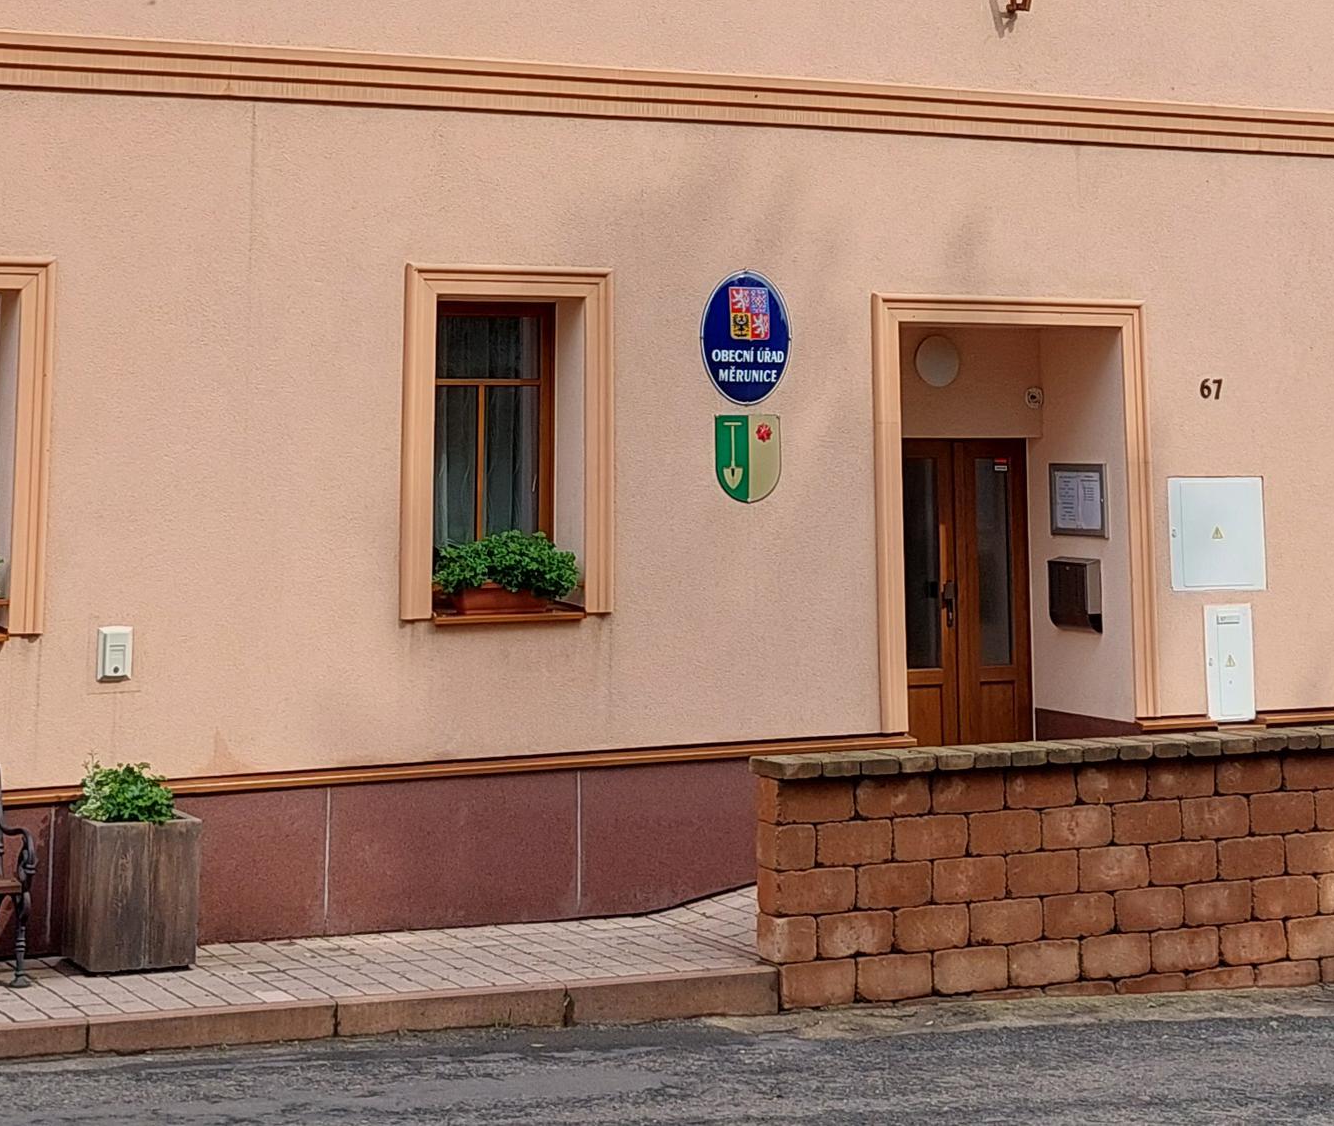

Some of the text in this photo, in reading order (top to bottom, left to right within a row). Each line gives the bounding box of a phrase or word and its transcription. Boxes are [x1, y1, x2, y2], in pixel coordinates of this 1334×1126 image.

[711, 347, 785, 363] OBECNÍ ÚŘAD
[718, 366, 777, 383] MĚRUNICE
[1199, 377, 1223, 400] 67
